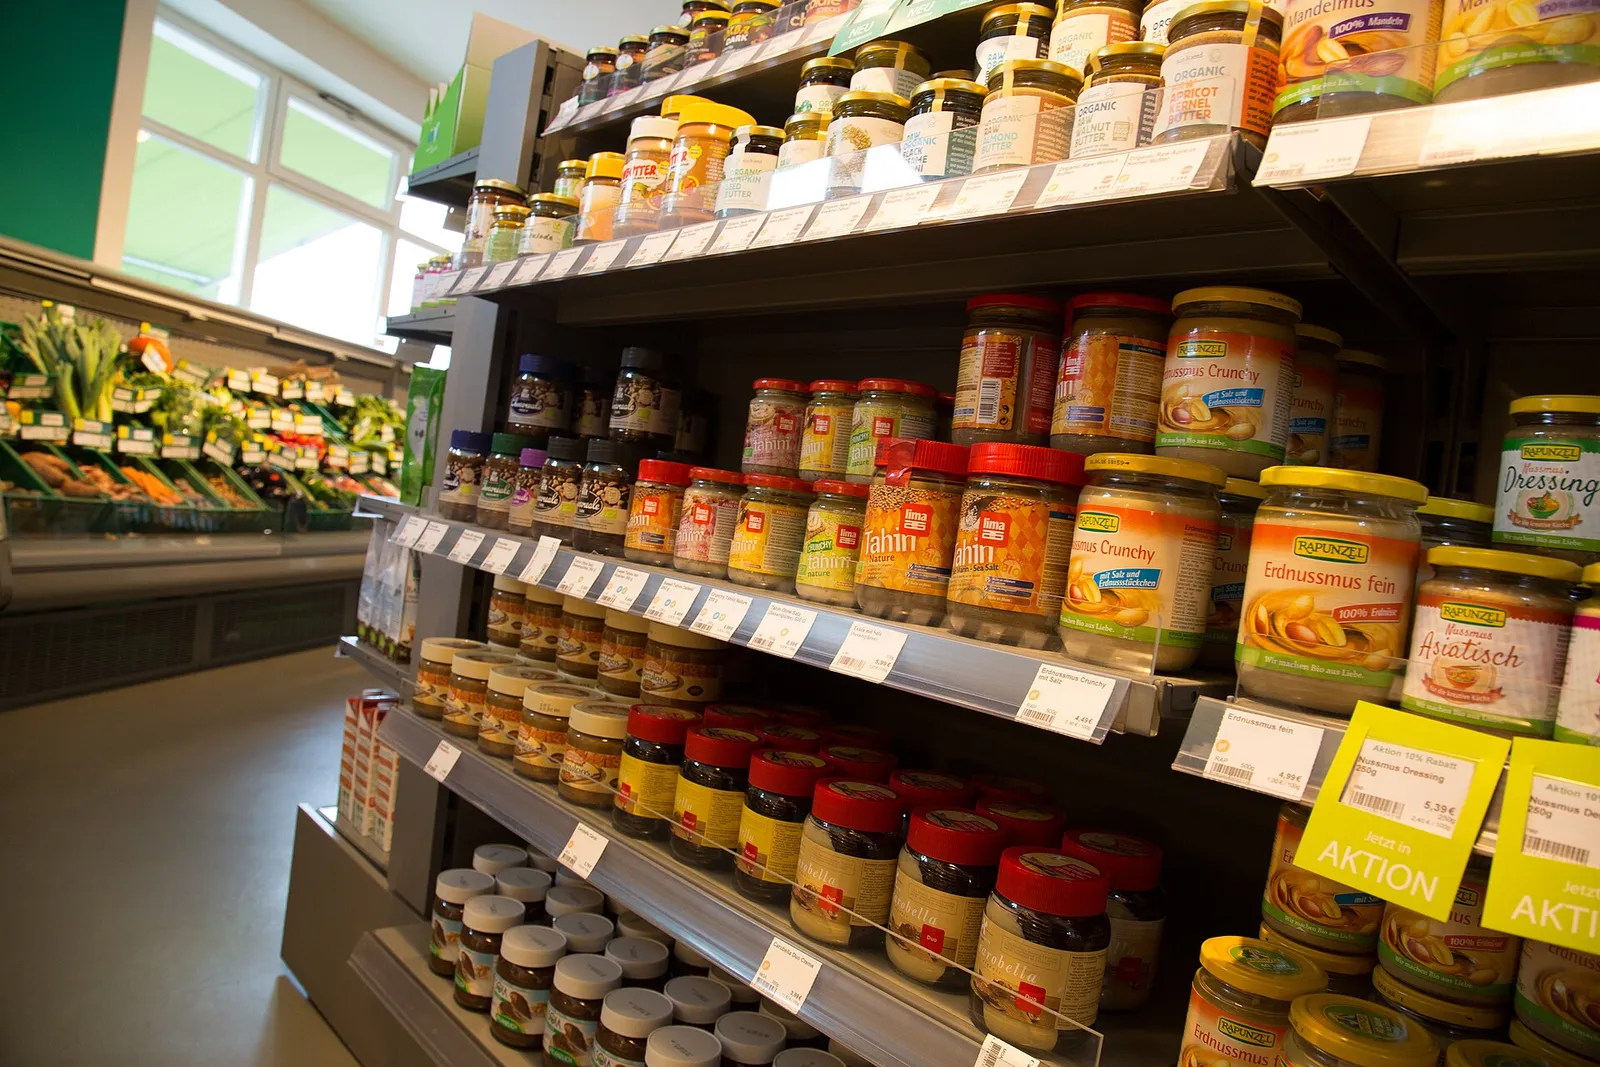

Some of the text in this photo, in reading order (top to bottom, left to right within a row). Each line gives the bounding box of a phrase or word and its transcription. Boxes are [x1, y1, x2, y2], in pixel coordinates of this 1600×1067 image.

[907, 2, 935, 18] NEU
[848, 20, 875, 38] NEU
[1334, 19, 1365, 34] 100%
[726, 33, 748, 43] DARK
[1058, 31, 1094, 46] ORGANIC
[1056, 43, 1073, 54] RAW
[988, 52, 1005, 62] RAW
[1174, 66, 1225, 82] ORGANIC
[1170, 87, 1219, 104] APRICOT
[1078, 101, 1117, 117] ORGANIC
[1169, 98, 1211, 113] KERNEL
[985, 115, 1023, 127] ORGANIC
[1077, 115, 1093, 127] RAW
[1168, 110, 1212, 125] BUTTER
[984, 124, 1000, 136] RAW
[1076, 122, 1111, 137] WALNUT
[903, 137, 937, 149] ORGANIC
[983, 132, 1019, 145] ALMOND
[1074, 133, 1105, 148] BUTTER
[903, 147, 922, 158] BLACK
[982, 142, 1013, 154] BUTTER
[1178, 342, 1225, 356] RAPUNZEL
[1208, 364, 1260, 384] Crunchy
[1208, 390, 1248, 400] mit Salz und
[779, 416, 793, 425] lima
[815, 417, 828, 426] lima
[875, 420, 891, 429] lima
[753, 436, 792, 452] tahini
[1523, 446, 1579, 460] RAPUNZEL
[852, 458, 869, 468] nature
[1522, 462, 1564, 475] Nussmus
[1504, 466, 1600, 508] Dressing
[749, 514, 763, 524] lima
[904, 508, 928, 522] lima
[1079, 514, 1117, 530] RAPUNZEL
[982, 518, 1006, 532] lima
[840, 528, 857, 539] lima
[807, 541, 832, 553] CRUNCHY
[864, 528, 916, 555] Tahin
[1297, 539, 1365, 559] RAPUNZEL
[868, 554, 895, 564] Nature
[923, 551, 941, 562] BIO
[1100, 540, 1156, 565] Crunchy
[807, 552, 851, 570] tahini
[973, 563, 1000, 572] Sea Salt
[807, 569, 831, 578] nature
[1001, 563, 1021, 577] BIO
[1100, 570, 1141, 580] mit Salz und
[1098, 578, 1157, 589] Erdnussstückchen
[1264, 561, 1397, 596] Erdnussmus fein
[1338, 607, 1368, 620] 100%
[1442, 605, 1505, 624] RAPUNZEL
[1076, 619, 1116, 633] Bio aus Liebe.
[1444, 623, 1493, 641] Nussmus
[1419, 630, 1523, 669] Asiatisch
[1264, 655, 1365, 679] Wir machen Bio aus Liebe.
[1038, 674, 1063, 685] mit Salz
[1041, 667, 1107, 689] Erdnussmus Crunchy
[1228, 713, 1294, 735] Erdnussmus fein
[1214, 755, 1256, 772] RAP 500g
[1372, 744, 1458, 770] Aktion 10% Rabatt
[1355, 764, 1378, 777] 250g
[1358, 756, 1446, 785] Nussmus Dressing
[1545, 783, 1581, 799] Aktion
[1527, 805, 1553, 820] 250g
[1528, 795, 1581, 815] Nussmus
[1363, 830, 1412, 856] Jetzt in
[1316, 839, 1440, 903] AKTION
[1562, 880, 1600, 899] Jetzt
[1284, 914, 1340, 937] Wir machen Bio aus
[926, 934, 938, 944] Duo
[1449, 936, 1475, 947] 100%
[791, 952, 801, 961] Duo
[1395, 955, 1453, 981] Wir machen Bio aus
[1024, 992, 1038, 1002] Duo
[1221, 1021, 1273, 1044] RAPUNZEL
[1193, 1023, 1269, 1067] Erdnussmus
